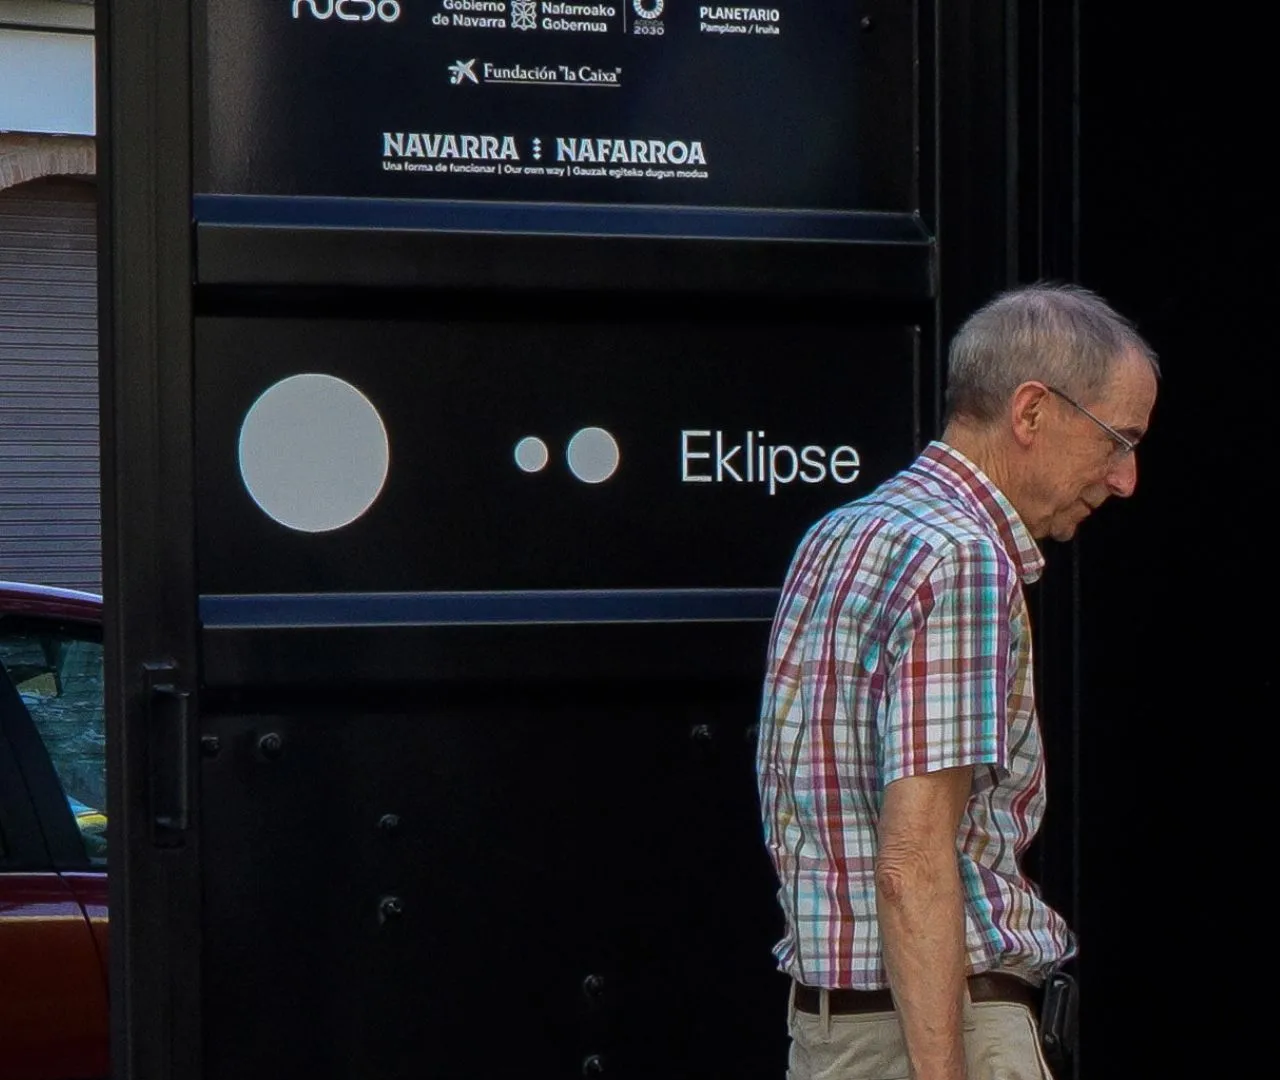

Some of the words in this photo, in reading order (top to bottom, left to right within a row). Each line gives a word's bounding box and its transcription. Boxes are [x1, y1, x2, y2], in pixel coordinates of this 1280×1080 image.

[542, 2, 616, 17] Nafarroako
[700, 6, 780, 22] PLANETARIO
[453, 14, 506, 28] Navarra
[542, 18, 608, 32] Gobernua
[633, 26, 665, 36] 2030
[483, 62, 557, 80] Fundación
[383, 132, 520, 160] NAVARRA
[556, 138, 707, 165] NAFARROA
[383, 161, 402, 171] Una
[403, 161, 433, 172] forma
[434, 161, 448, 172] de
[449, 162, 496, 174] funcionar
[504, 164, 522, 175] Our
[680, 429, 861, 496] Eklipse
